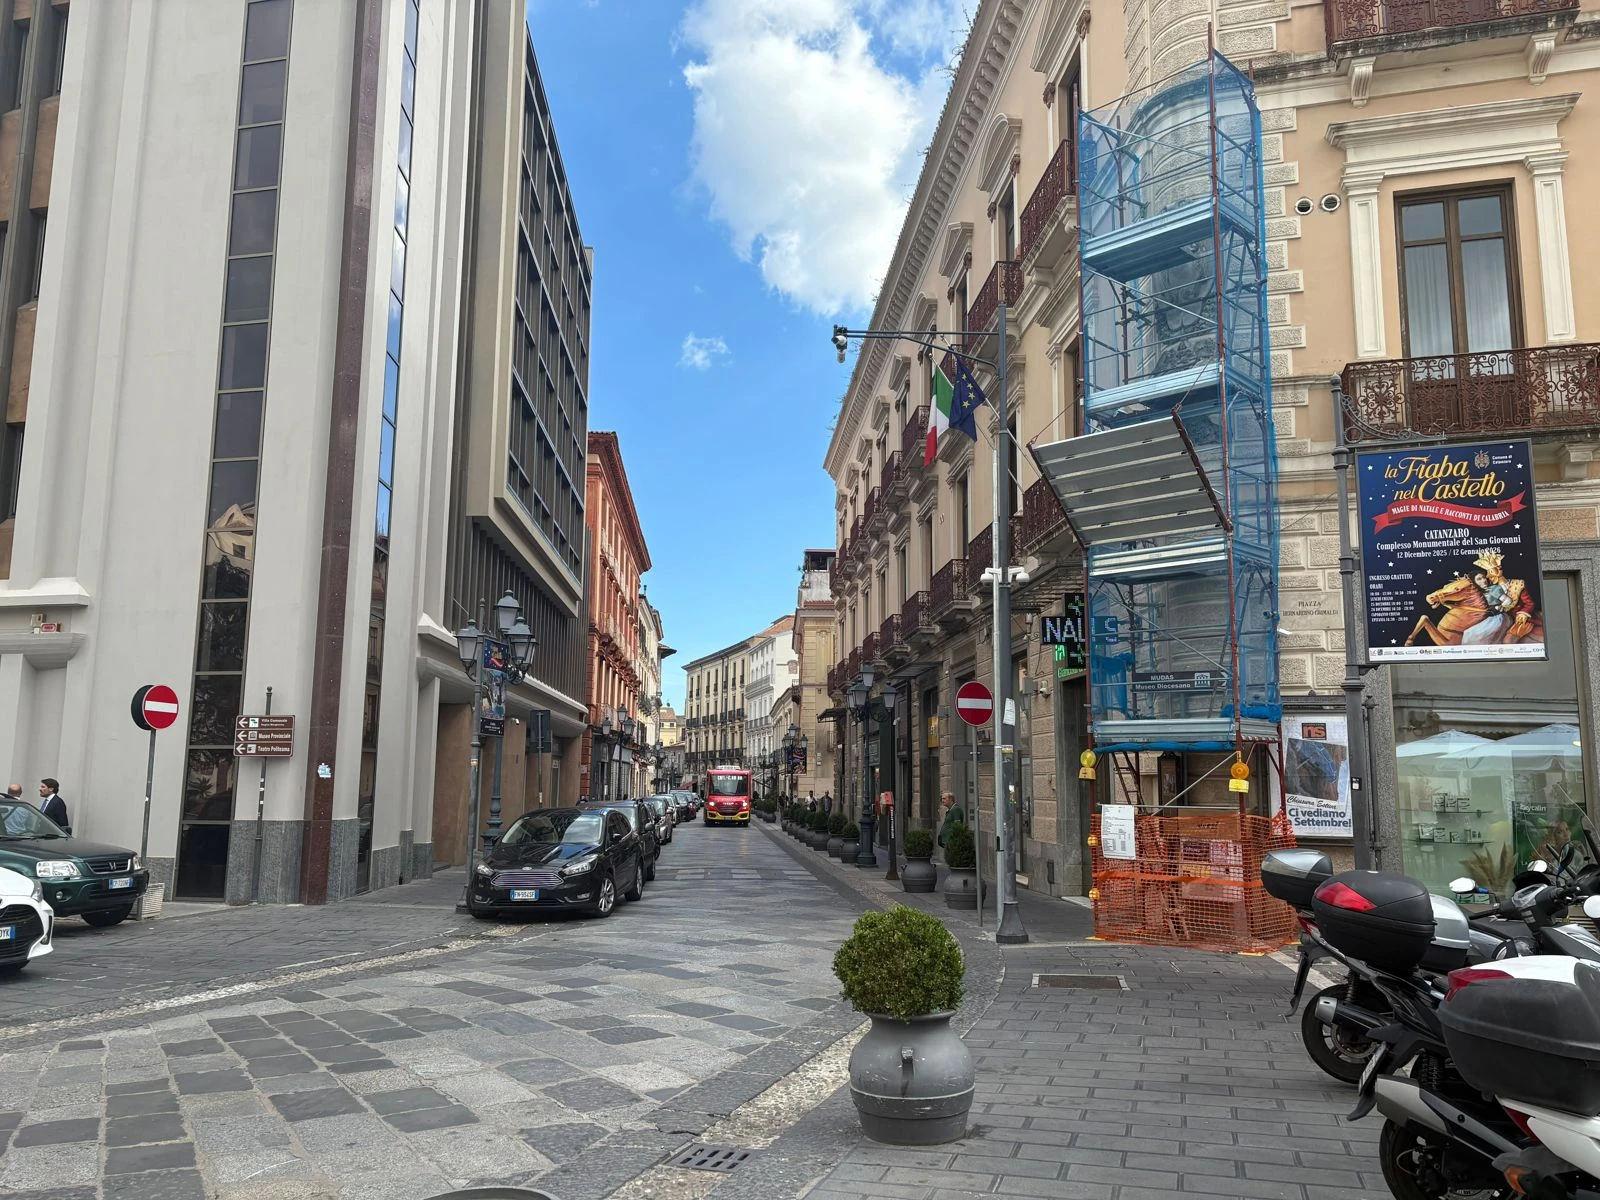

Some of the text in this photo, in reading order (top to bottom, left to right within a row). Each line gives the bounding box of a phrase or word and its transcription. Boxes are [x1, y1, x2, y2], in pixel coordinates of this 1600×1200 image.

[1384, 455, 1469, 484] la Fiaba
[1394, 472, 1505, 502] nel Castello
[1392, 504, 1410, 514] MAGIE
[1420, 504, 1439, 514] NATALE
[1444, 508, 1472, 520] RACCONTI
[1473, 513, 1480, 521] DI
[1481, 510, 1510, 522] CALABRIA
[1424, 528, 1470, 540] CATANZARO
[1376, 535, 1521, 552] Complesso Monumentale del San Giovanni
[1404, 550, 1432, 558] Dicembre
[1460, 548, 1485, 556] Gennaio
[1286, 796, 1314, 806] Chiusura
[1288, 808, 1346, 818] Ci vediamo
[1294, 818, 1352, 828] Settembre!
